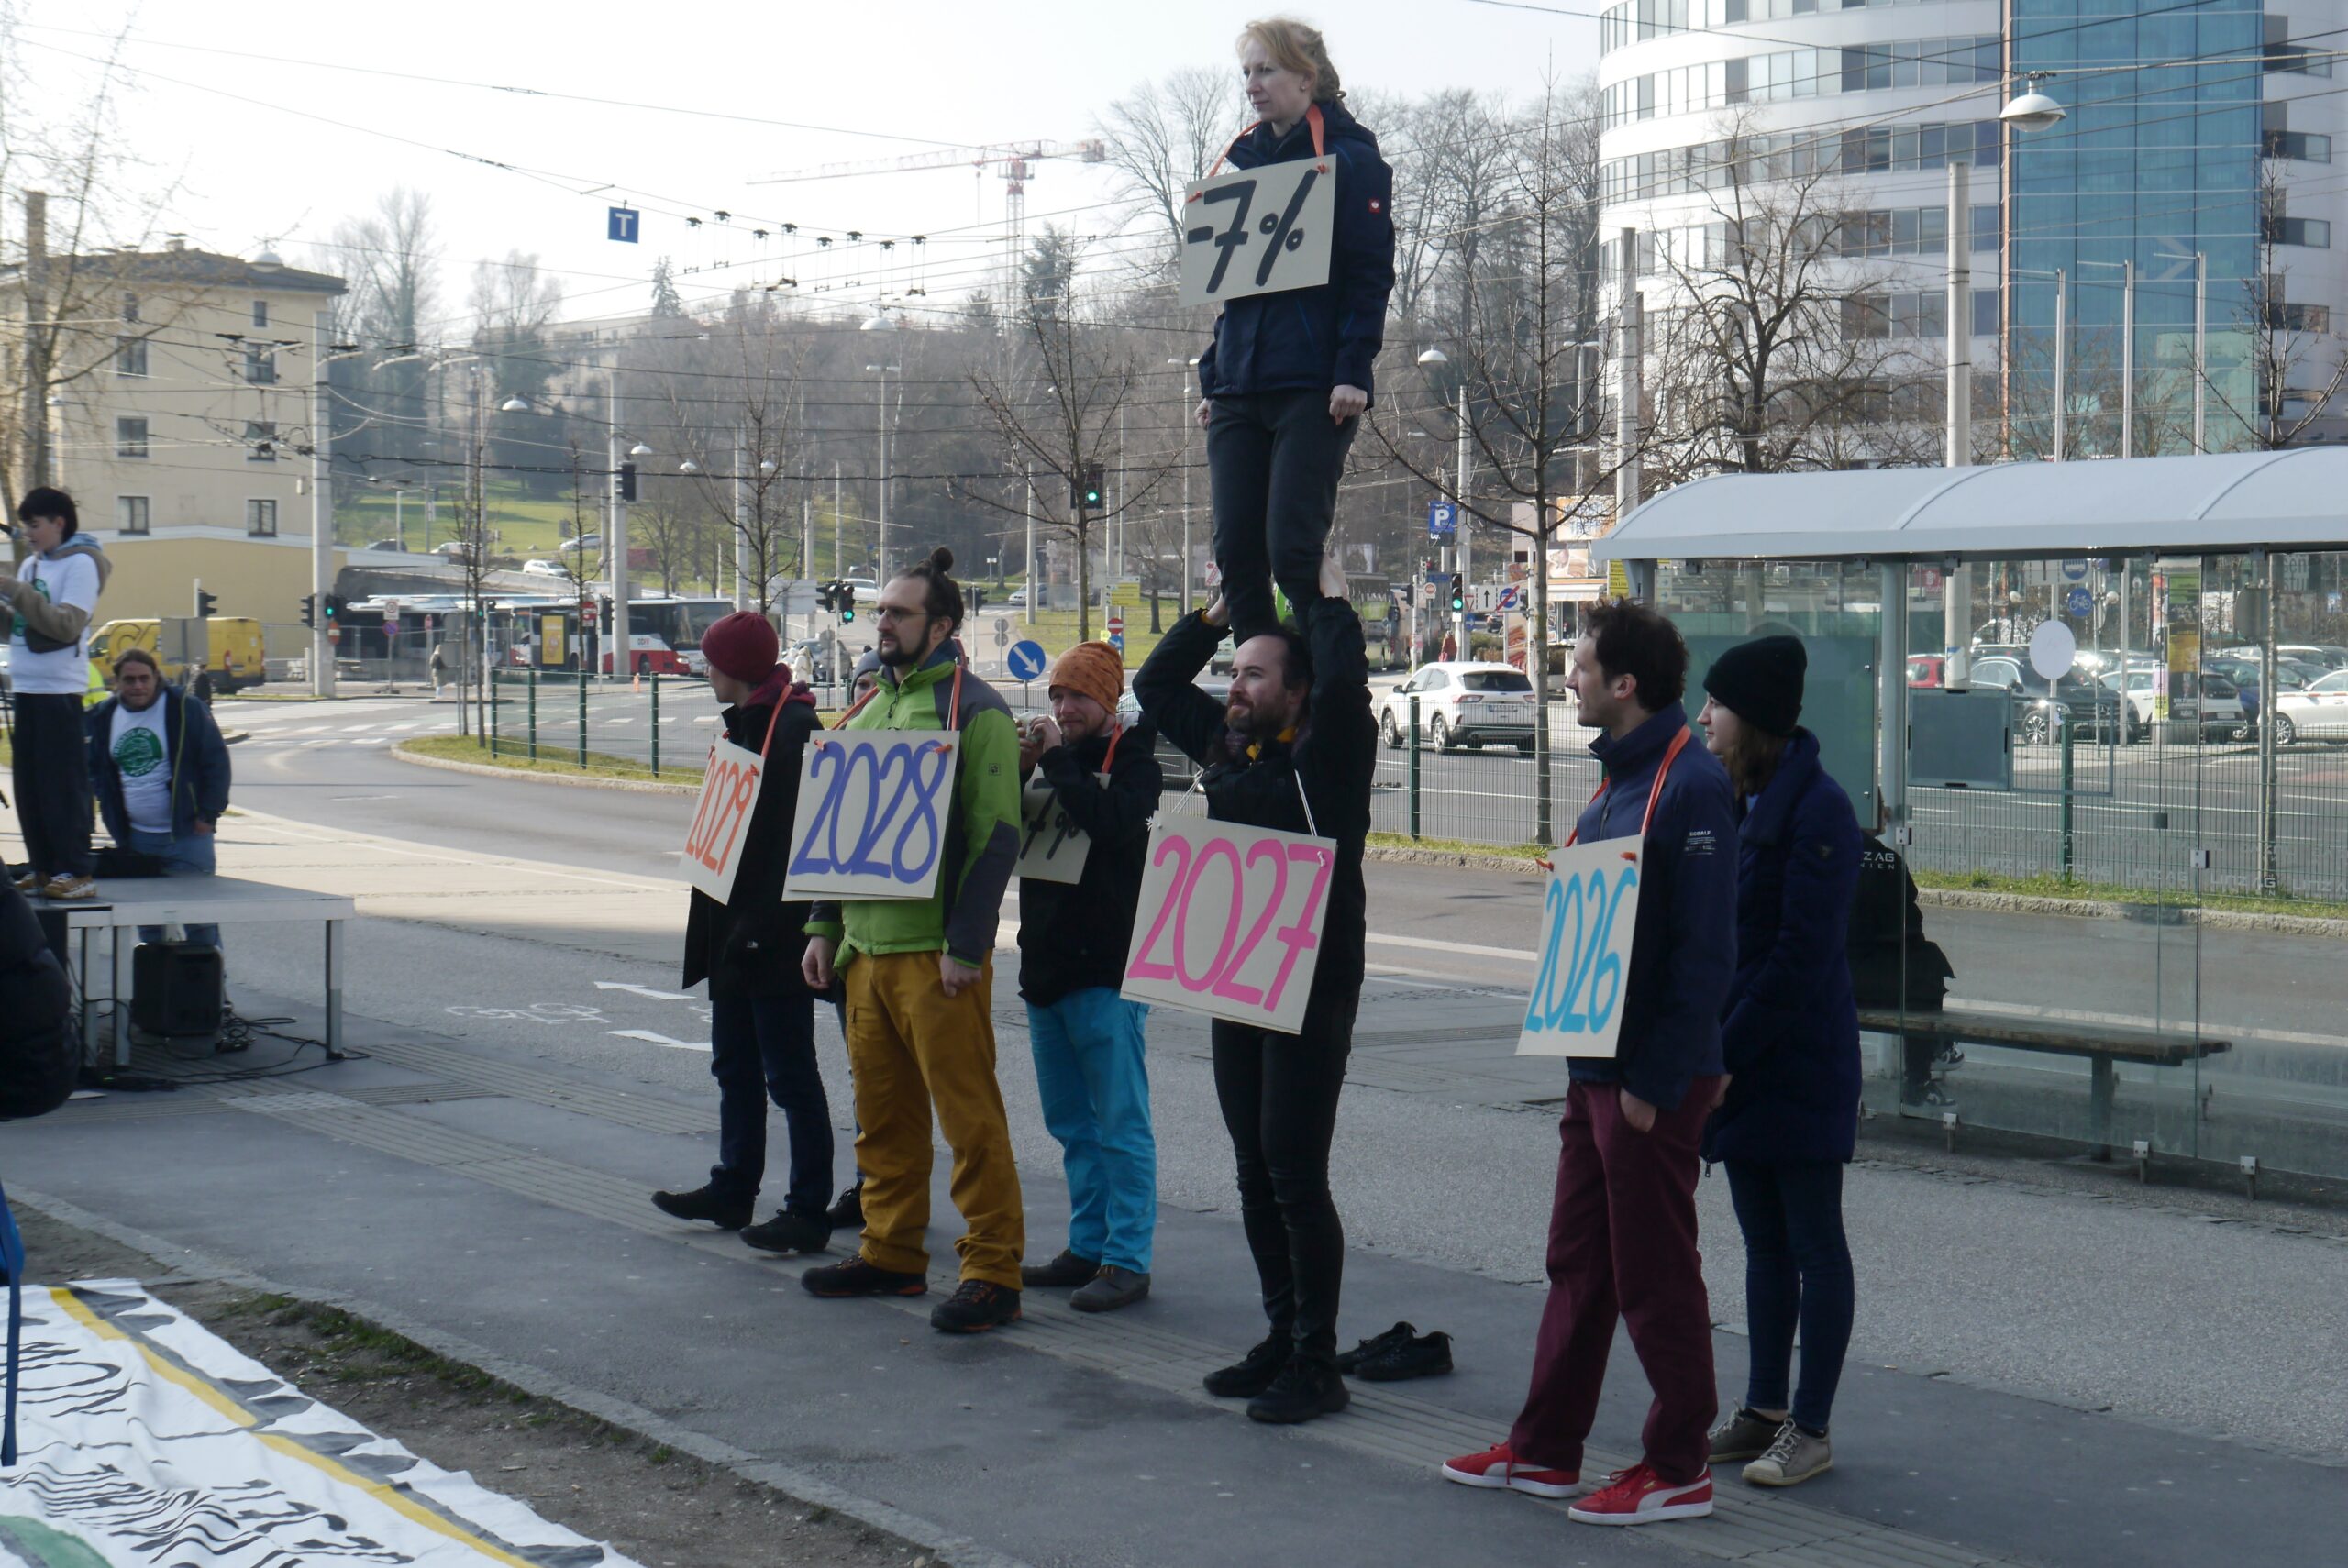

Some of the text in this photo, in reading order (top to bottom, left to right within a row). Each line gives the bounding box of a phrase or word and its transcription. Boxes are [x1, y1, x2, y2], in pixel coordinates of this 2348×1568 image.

[615, 213, 633, 237] T
[1188, 169, 1319, 293] -7%
[1434, 509, 1450, 526] P
[685, 754, 756, 877] 2029
[789, 739, 947, 884] 2028
[1127, 834, 1334, 1012] 2027
[1525, 867, 1637, 1033] 2026
